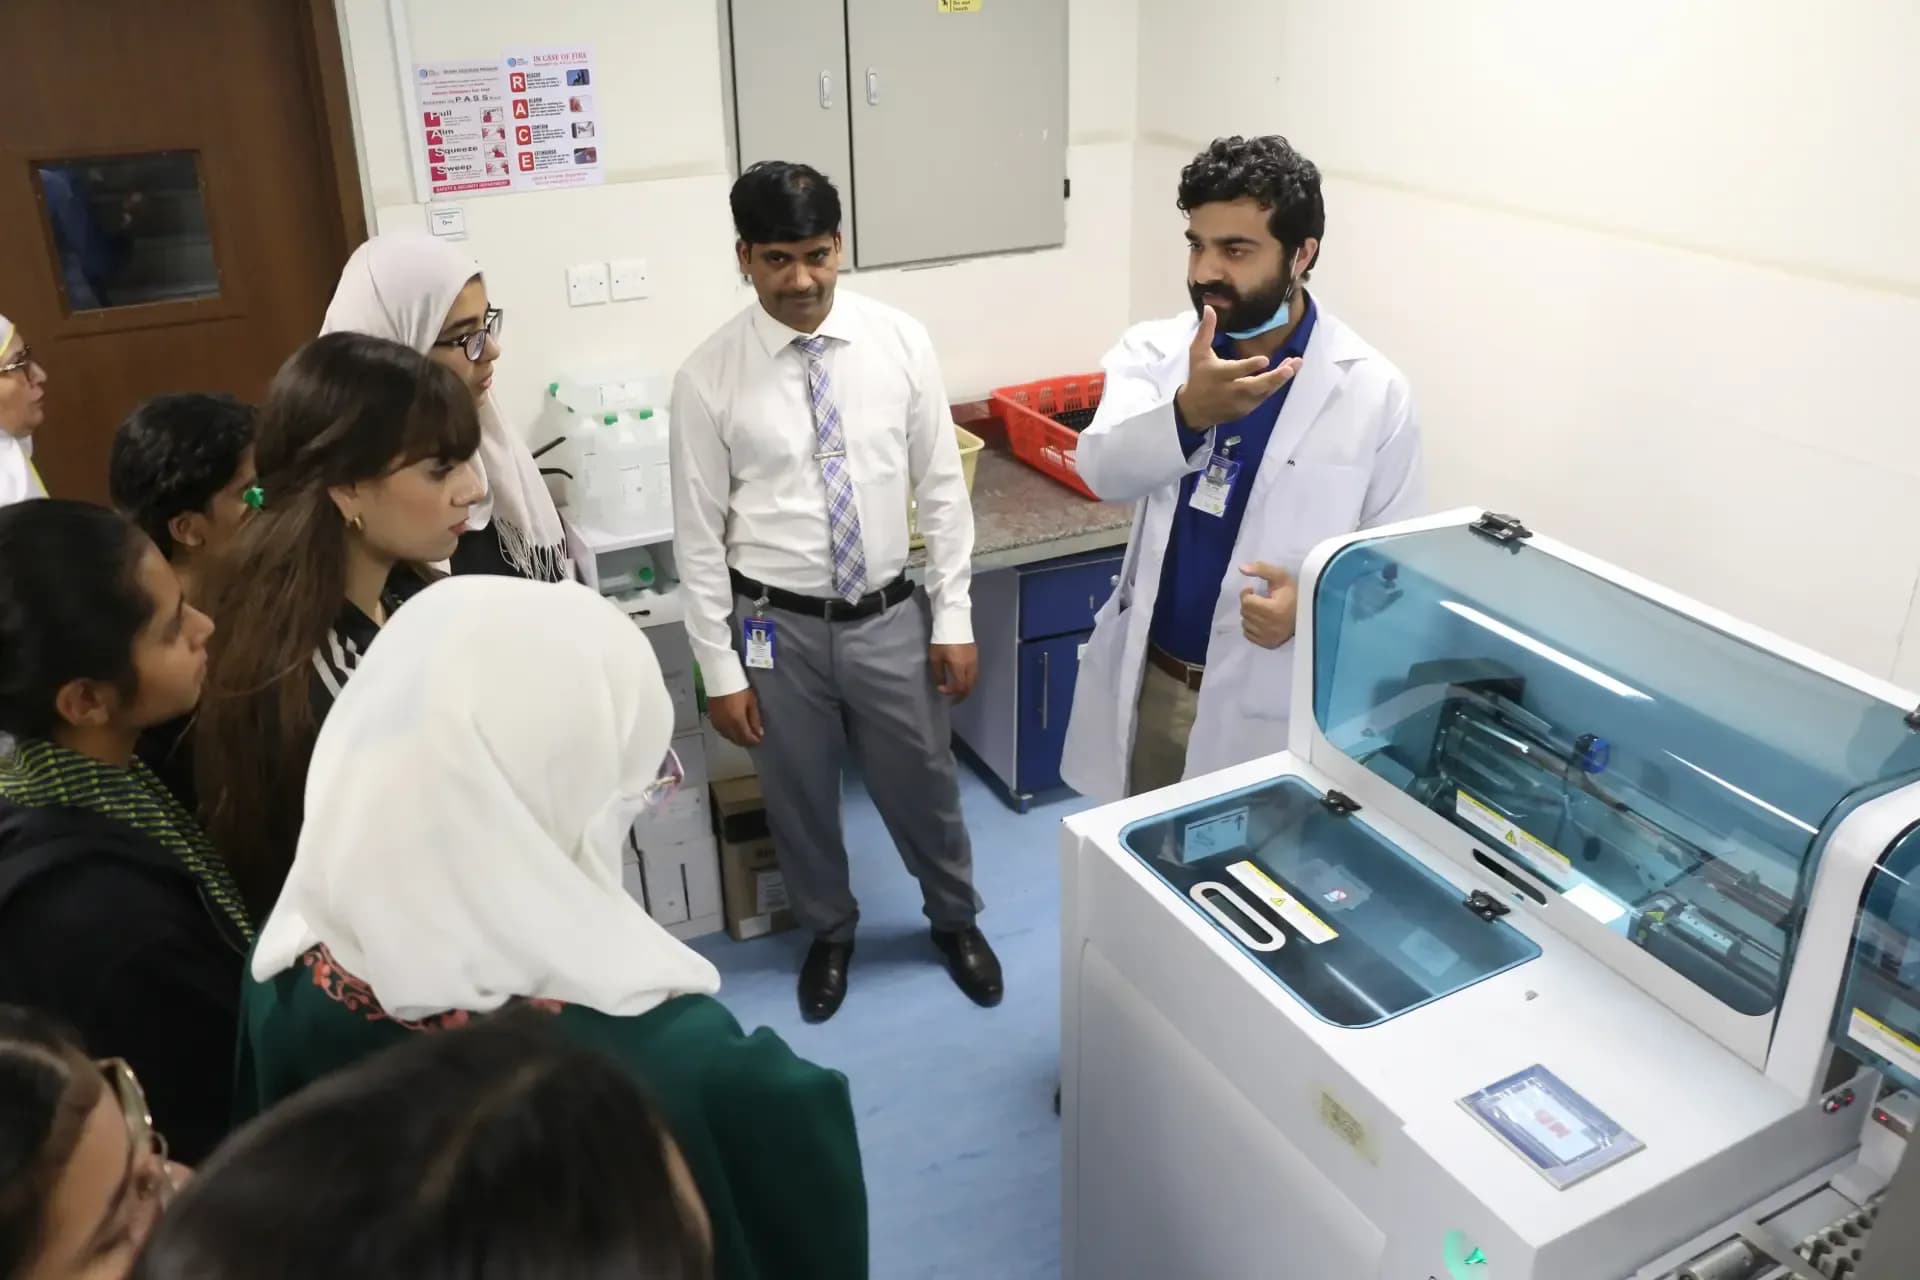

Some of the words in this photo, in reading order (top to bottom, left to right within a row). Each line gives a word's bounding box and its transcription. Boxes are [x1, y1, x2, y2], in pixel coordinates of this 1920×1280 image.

[512, 76, 524, 89] R
[515, 103, 526, 116] A
[431, 129, 454, 139] Aim
[518, 128, 529, 142] C
[435, 146, 479, 156] Squeeze
[521, 154, 532, 168] E
[436, 164, 472, 175] Sweep
